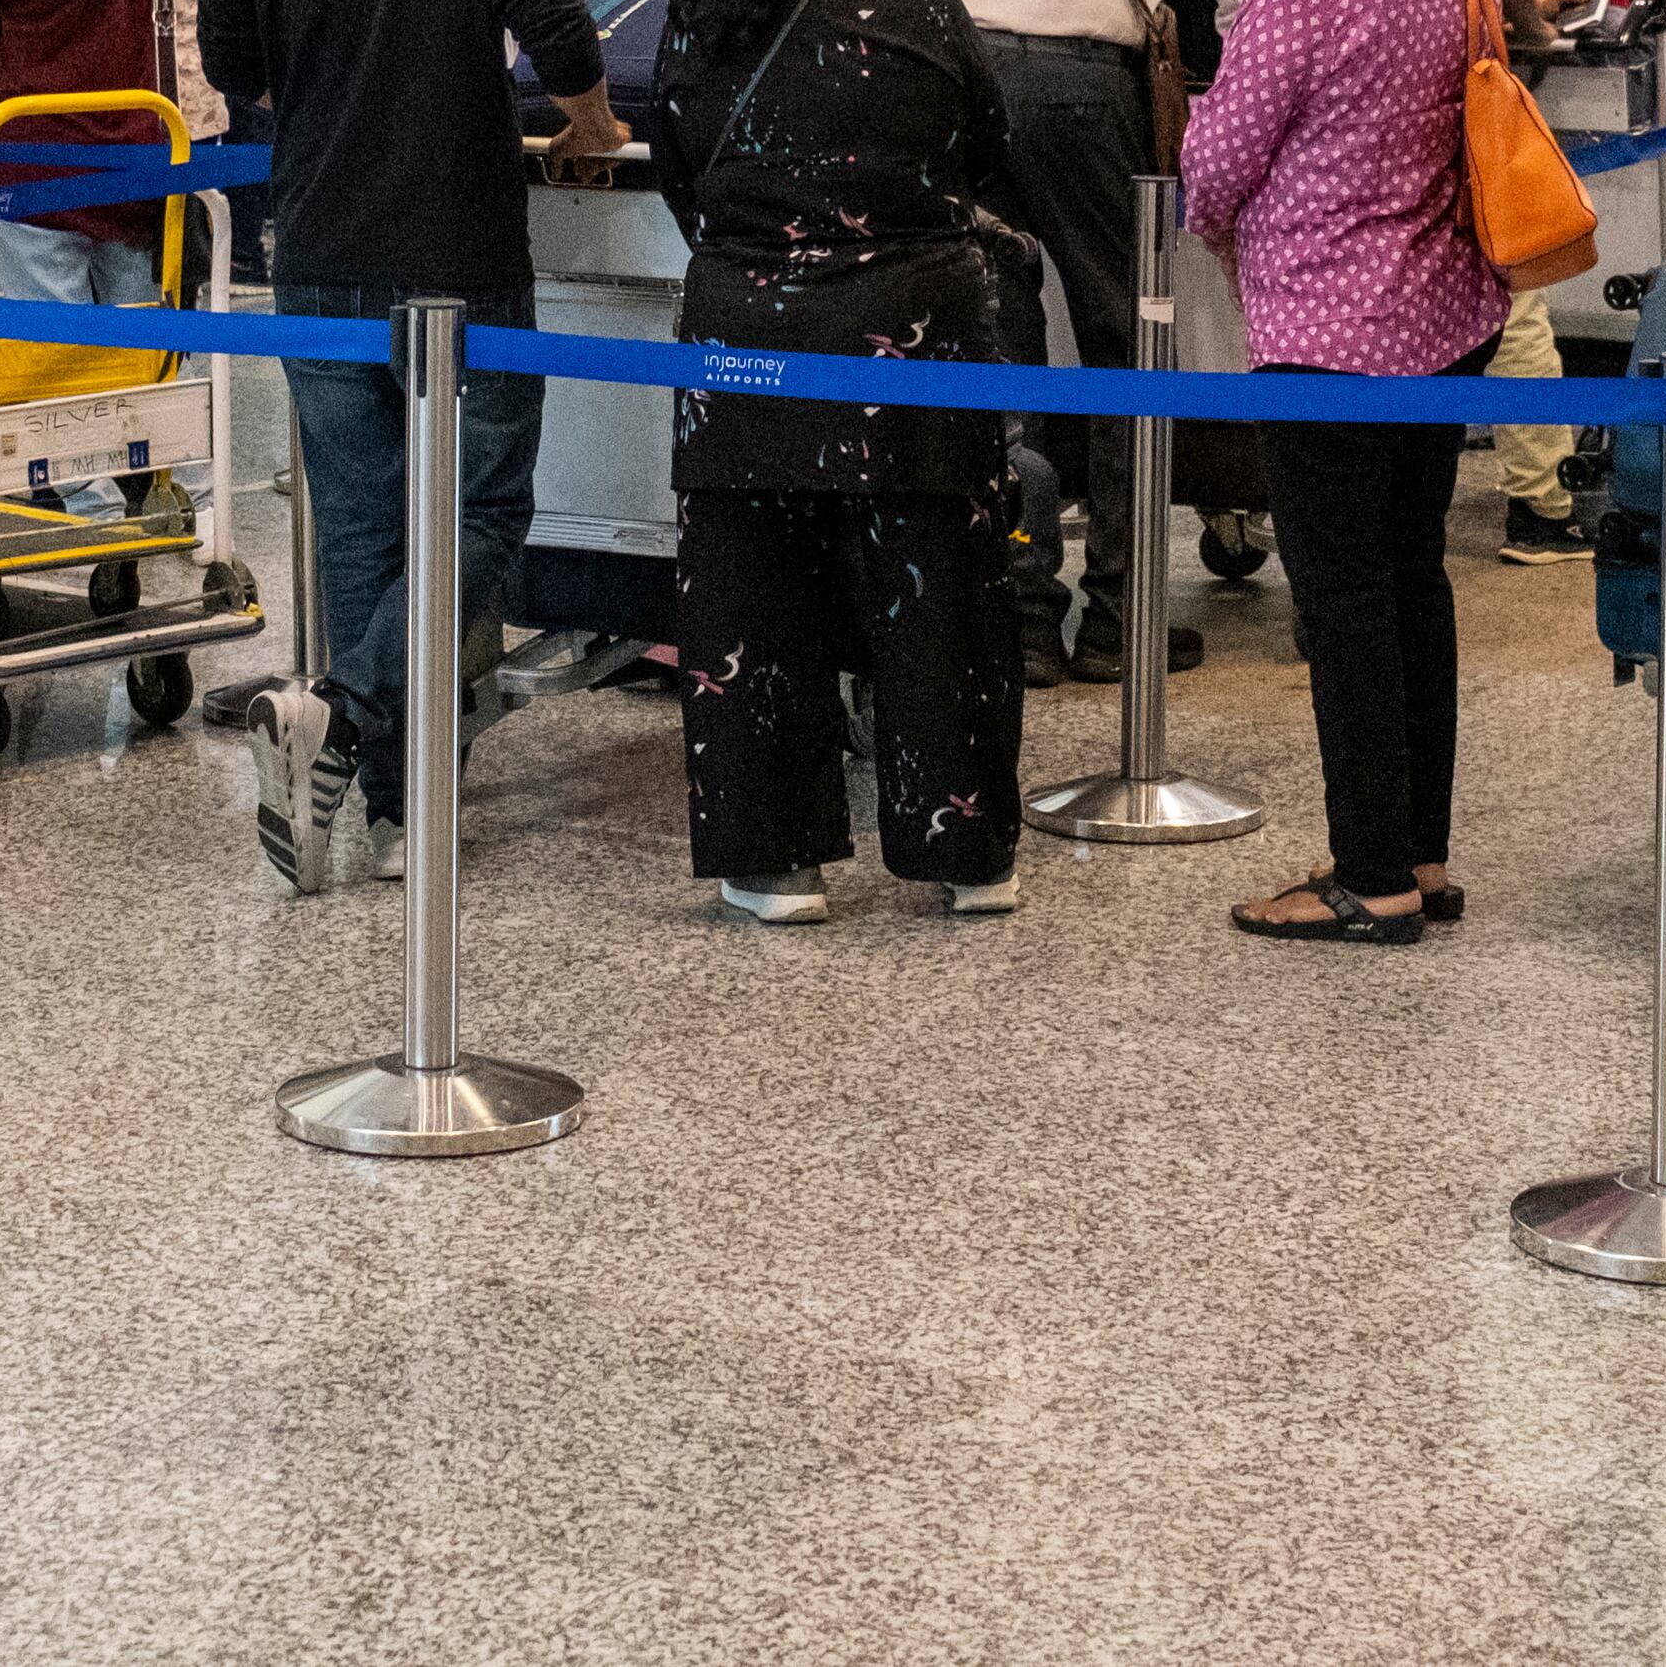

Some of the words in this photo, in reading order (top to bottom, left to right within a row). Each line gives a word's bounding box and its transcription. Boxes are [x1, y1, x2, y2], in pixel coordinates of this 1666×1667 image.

[704, 355, 786, 377] injourney
[706, 372, 781, 386] AIRPORTS
[24, 397, 134, 433] SILVER
